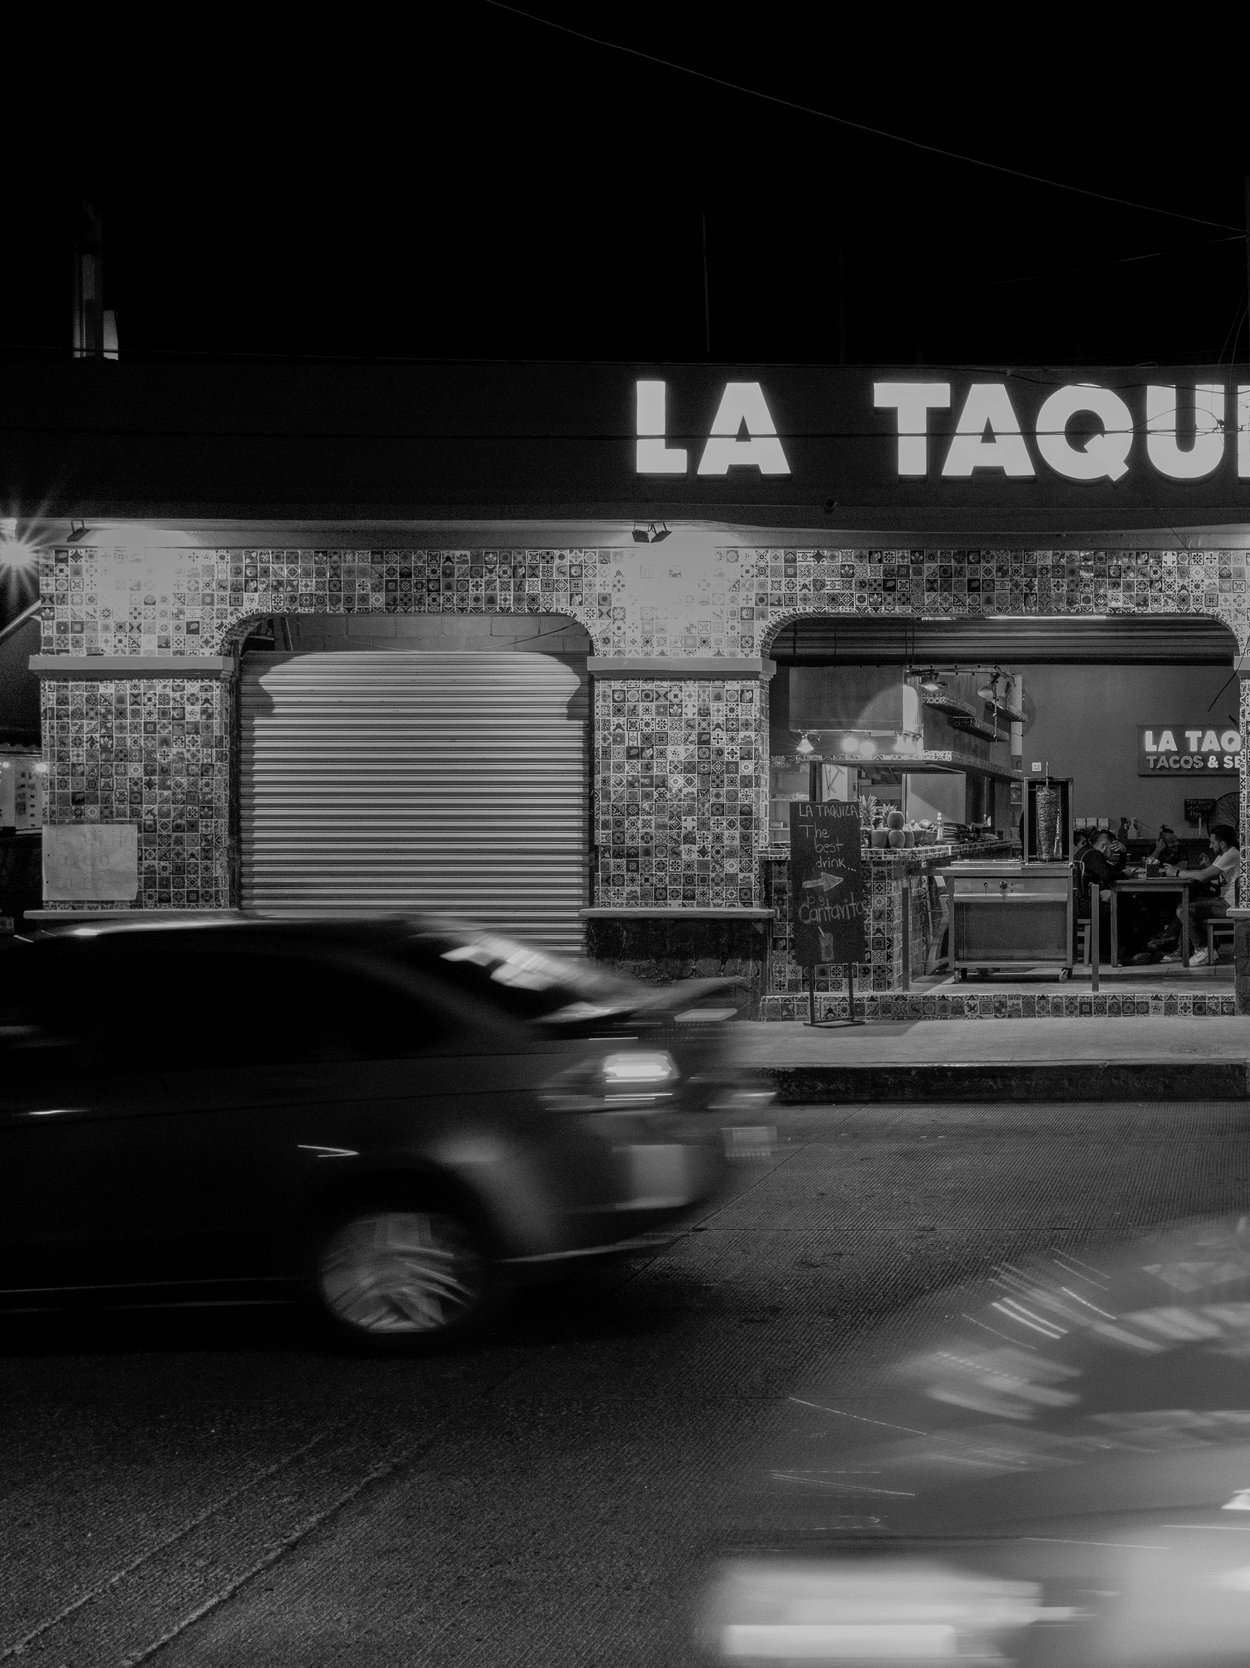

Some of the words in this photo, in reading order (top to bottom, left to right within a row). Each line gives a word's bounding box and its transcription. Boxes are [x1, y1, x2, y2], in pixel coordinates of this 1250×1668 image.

[636, 380, 791, 475] LA
[1144, 730, 1178, 752] LA
[1184, 730, 1241, 753] TAQ
[1146, 755, 1203, 769] TACOS
[1207, 755, 1219, 769] &
[799, 803, 814, 818] LA
[815, 804, 859, 819] TAQUIZA
[799, 822, 830, 839] The
[814, 836, 844, 853] best
